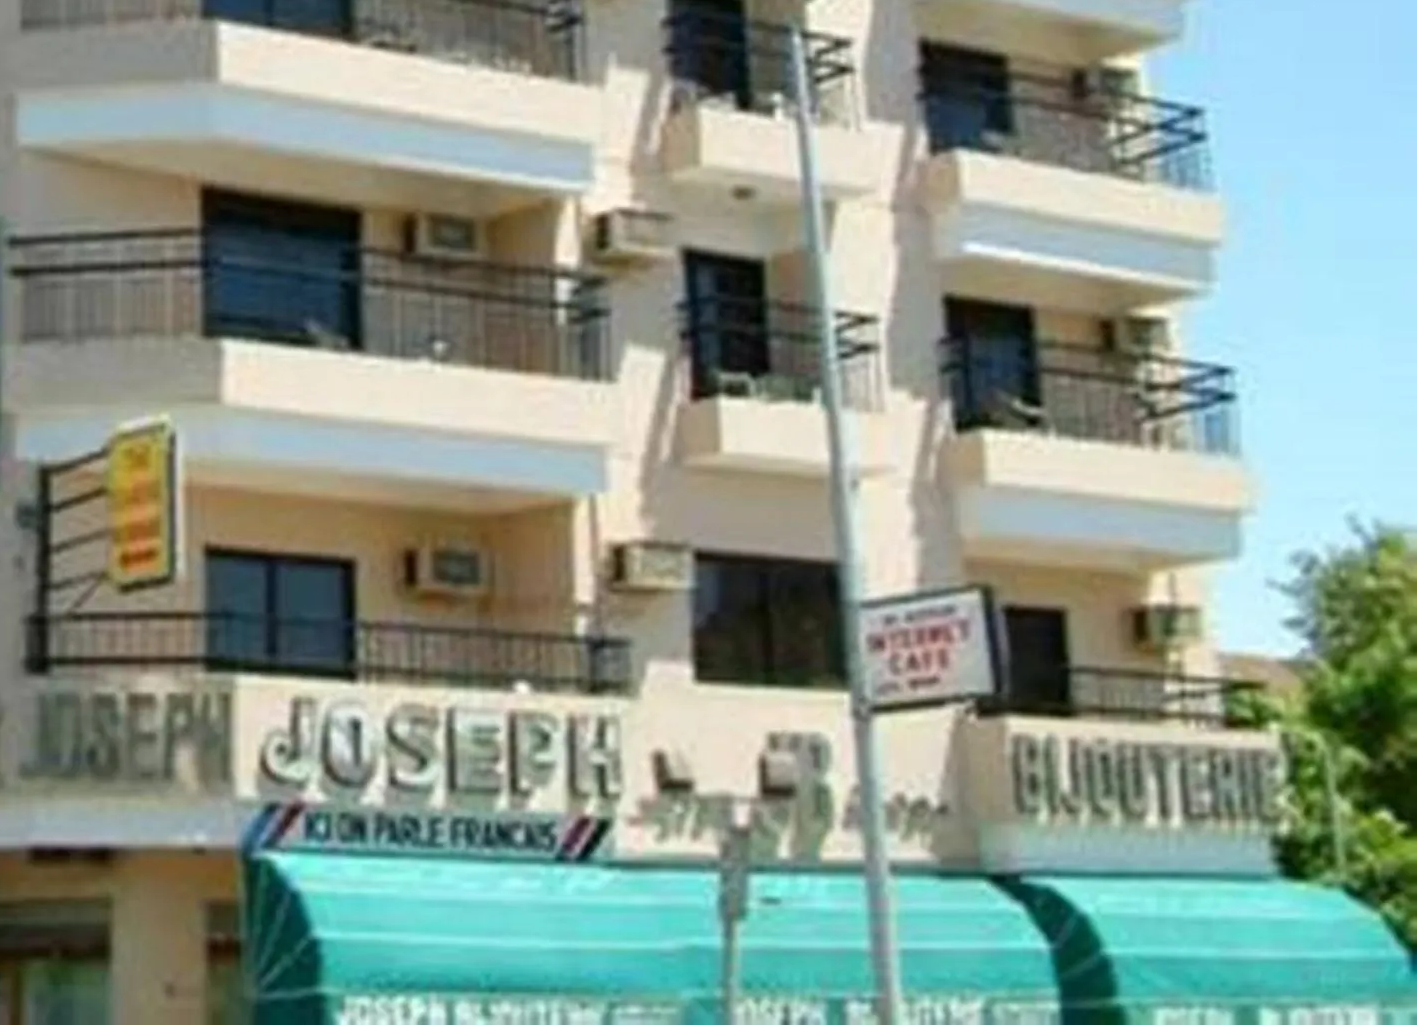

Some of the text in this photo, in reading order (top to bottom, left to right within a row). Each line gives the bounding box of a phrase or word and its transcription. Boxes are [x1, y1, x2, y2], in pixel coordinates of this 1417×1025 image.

[866, 619, 970, 655] INTERNET
[19, 690, 235, 785] JOSEPH
[261, 695, 624, 800] JOSEPH
[1011, 732, 1283, 825] BIJOUTERIE
[337, 813, 368, 843] ON
[374, 812, 448, 848] PARLE
